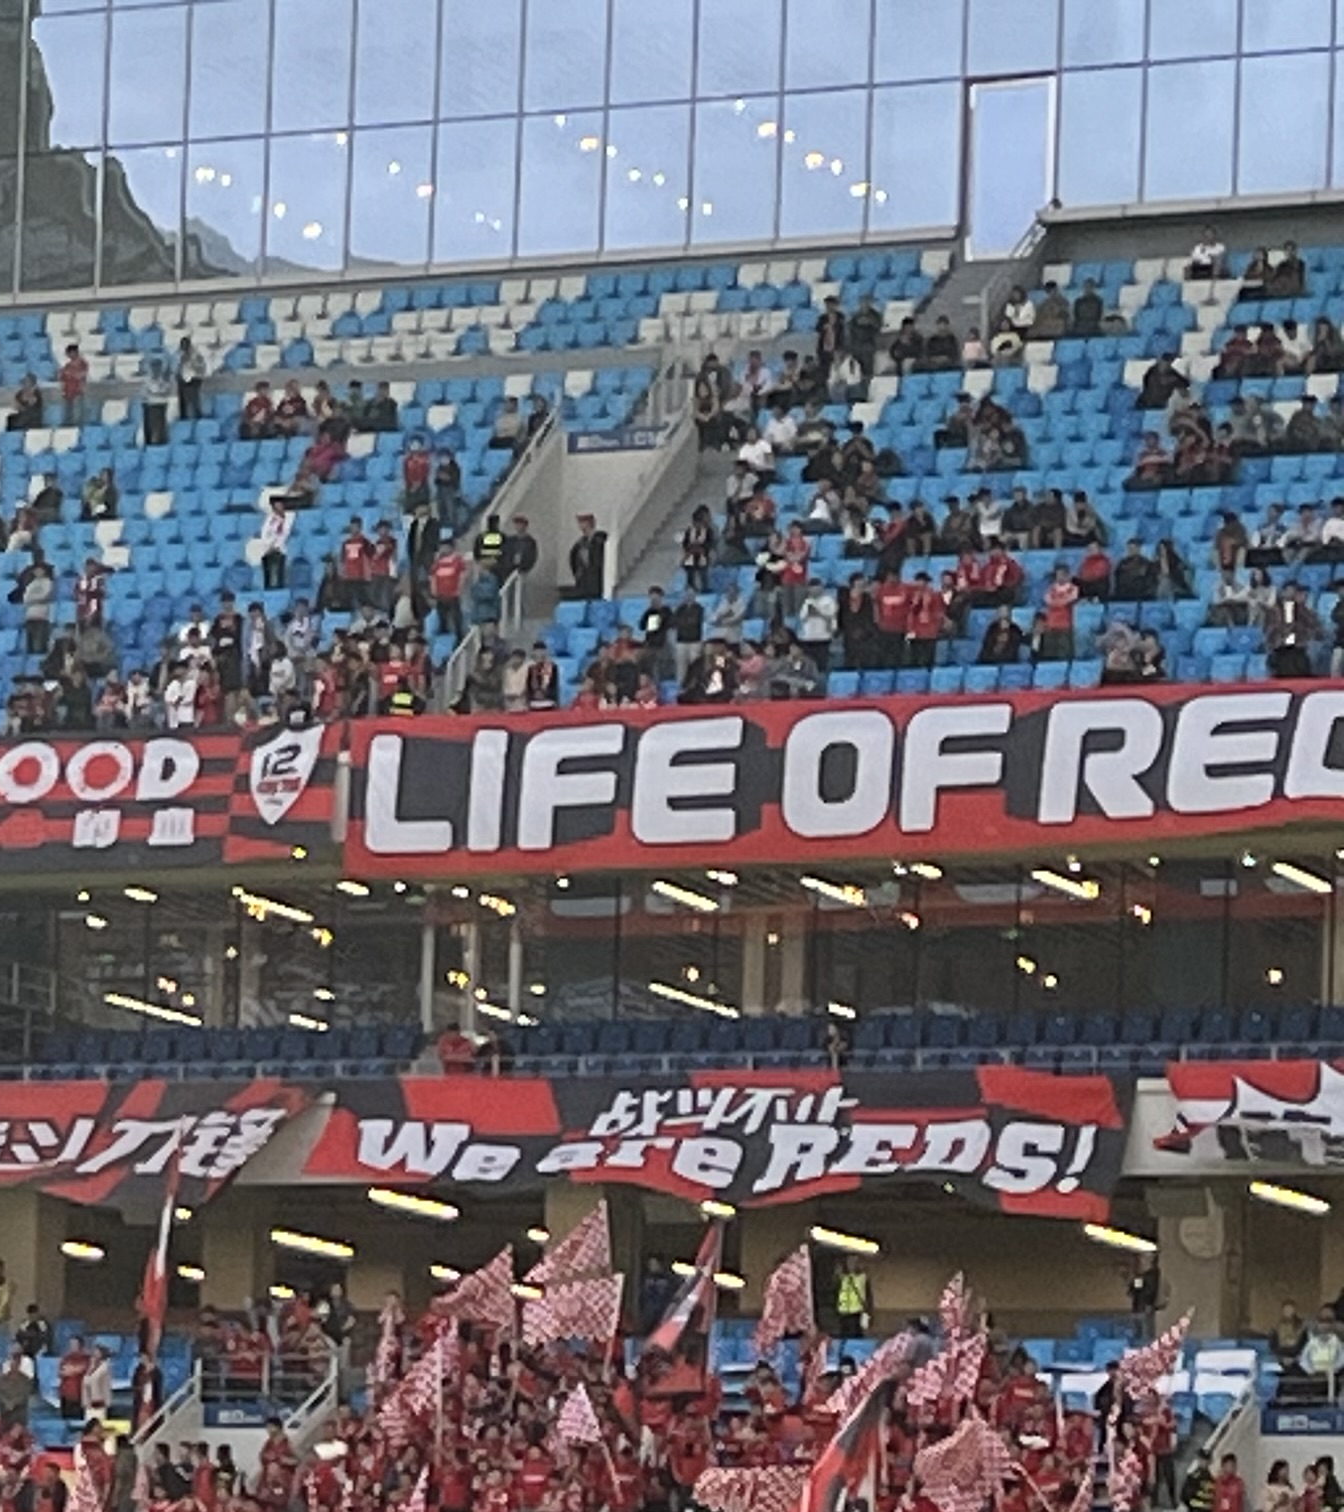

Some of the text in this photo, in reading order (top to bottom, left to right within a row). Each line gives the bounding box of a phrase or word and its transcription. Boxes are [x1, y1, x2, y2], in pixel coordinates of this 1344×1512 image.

[261, 743, 302, 778] 12
[363, 715, 744, 853] LIFE
[781, 701, 1013, 838] OF
[355, 1115, 1097, 1194] We are REDS!
